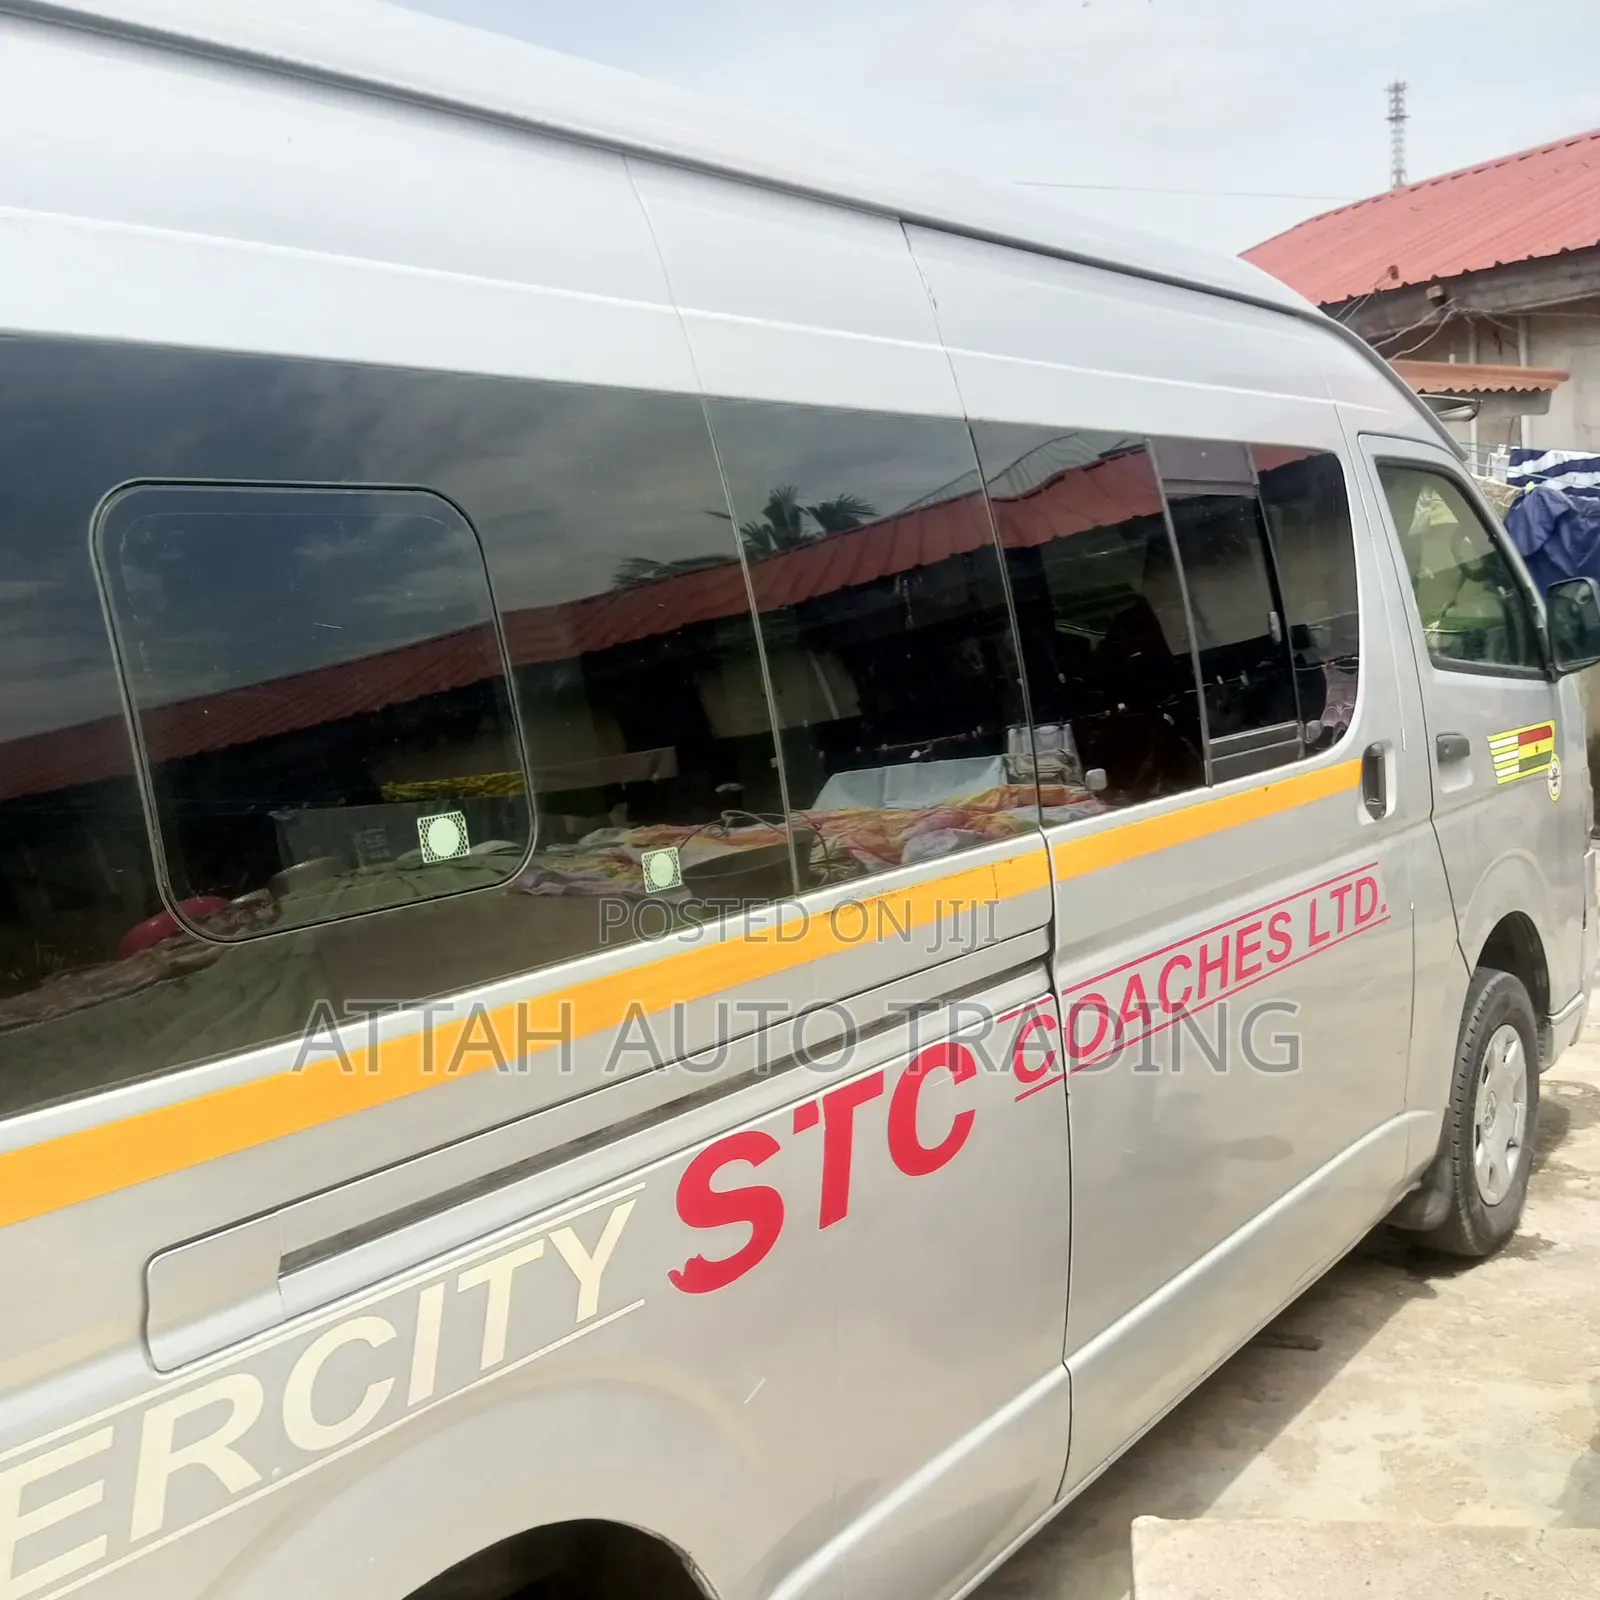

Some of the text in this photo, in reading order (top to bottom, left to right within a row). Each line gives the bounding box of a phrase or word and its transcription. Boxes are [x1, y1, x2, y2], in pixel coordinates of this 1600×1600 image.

[0, 875, 1389, 1600] ERCITY STC COACHES LTD.
